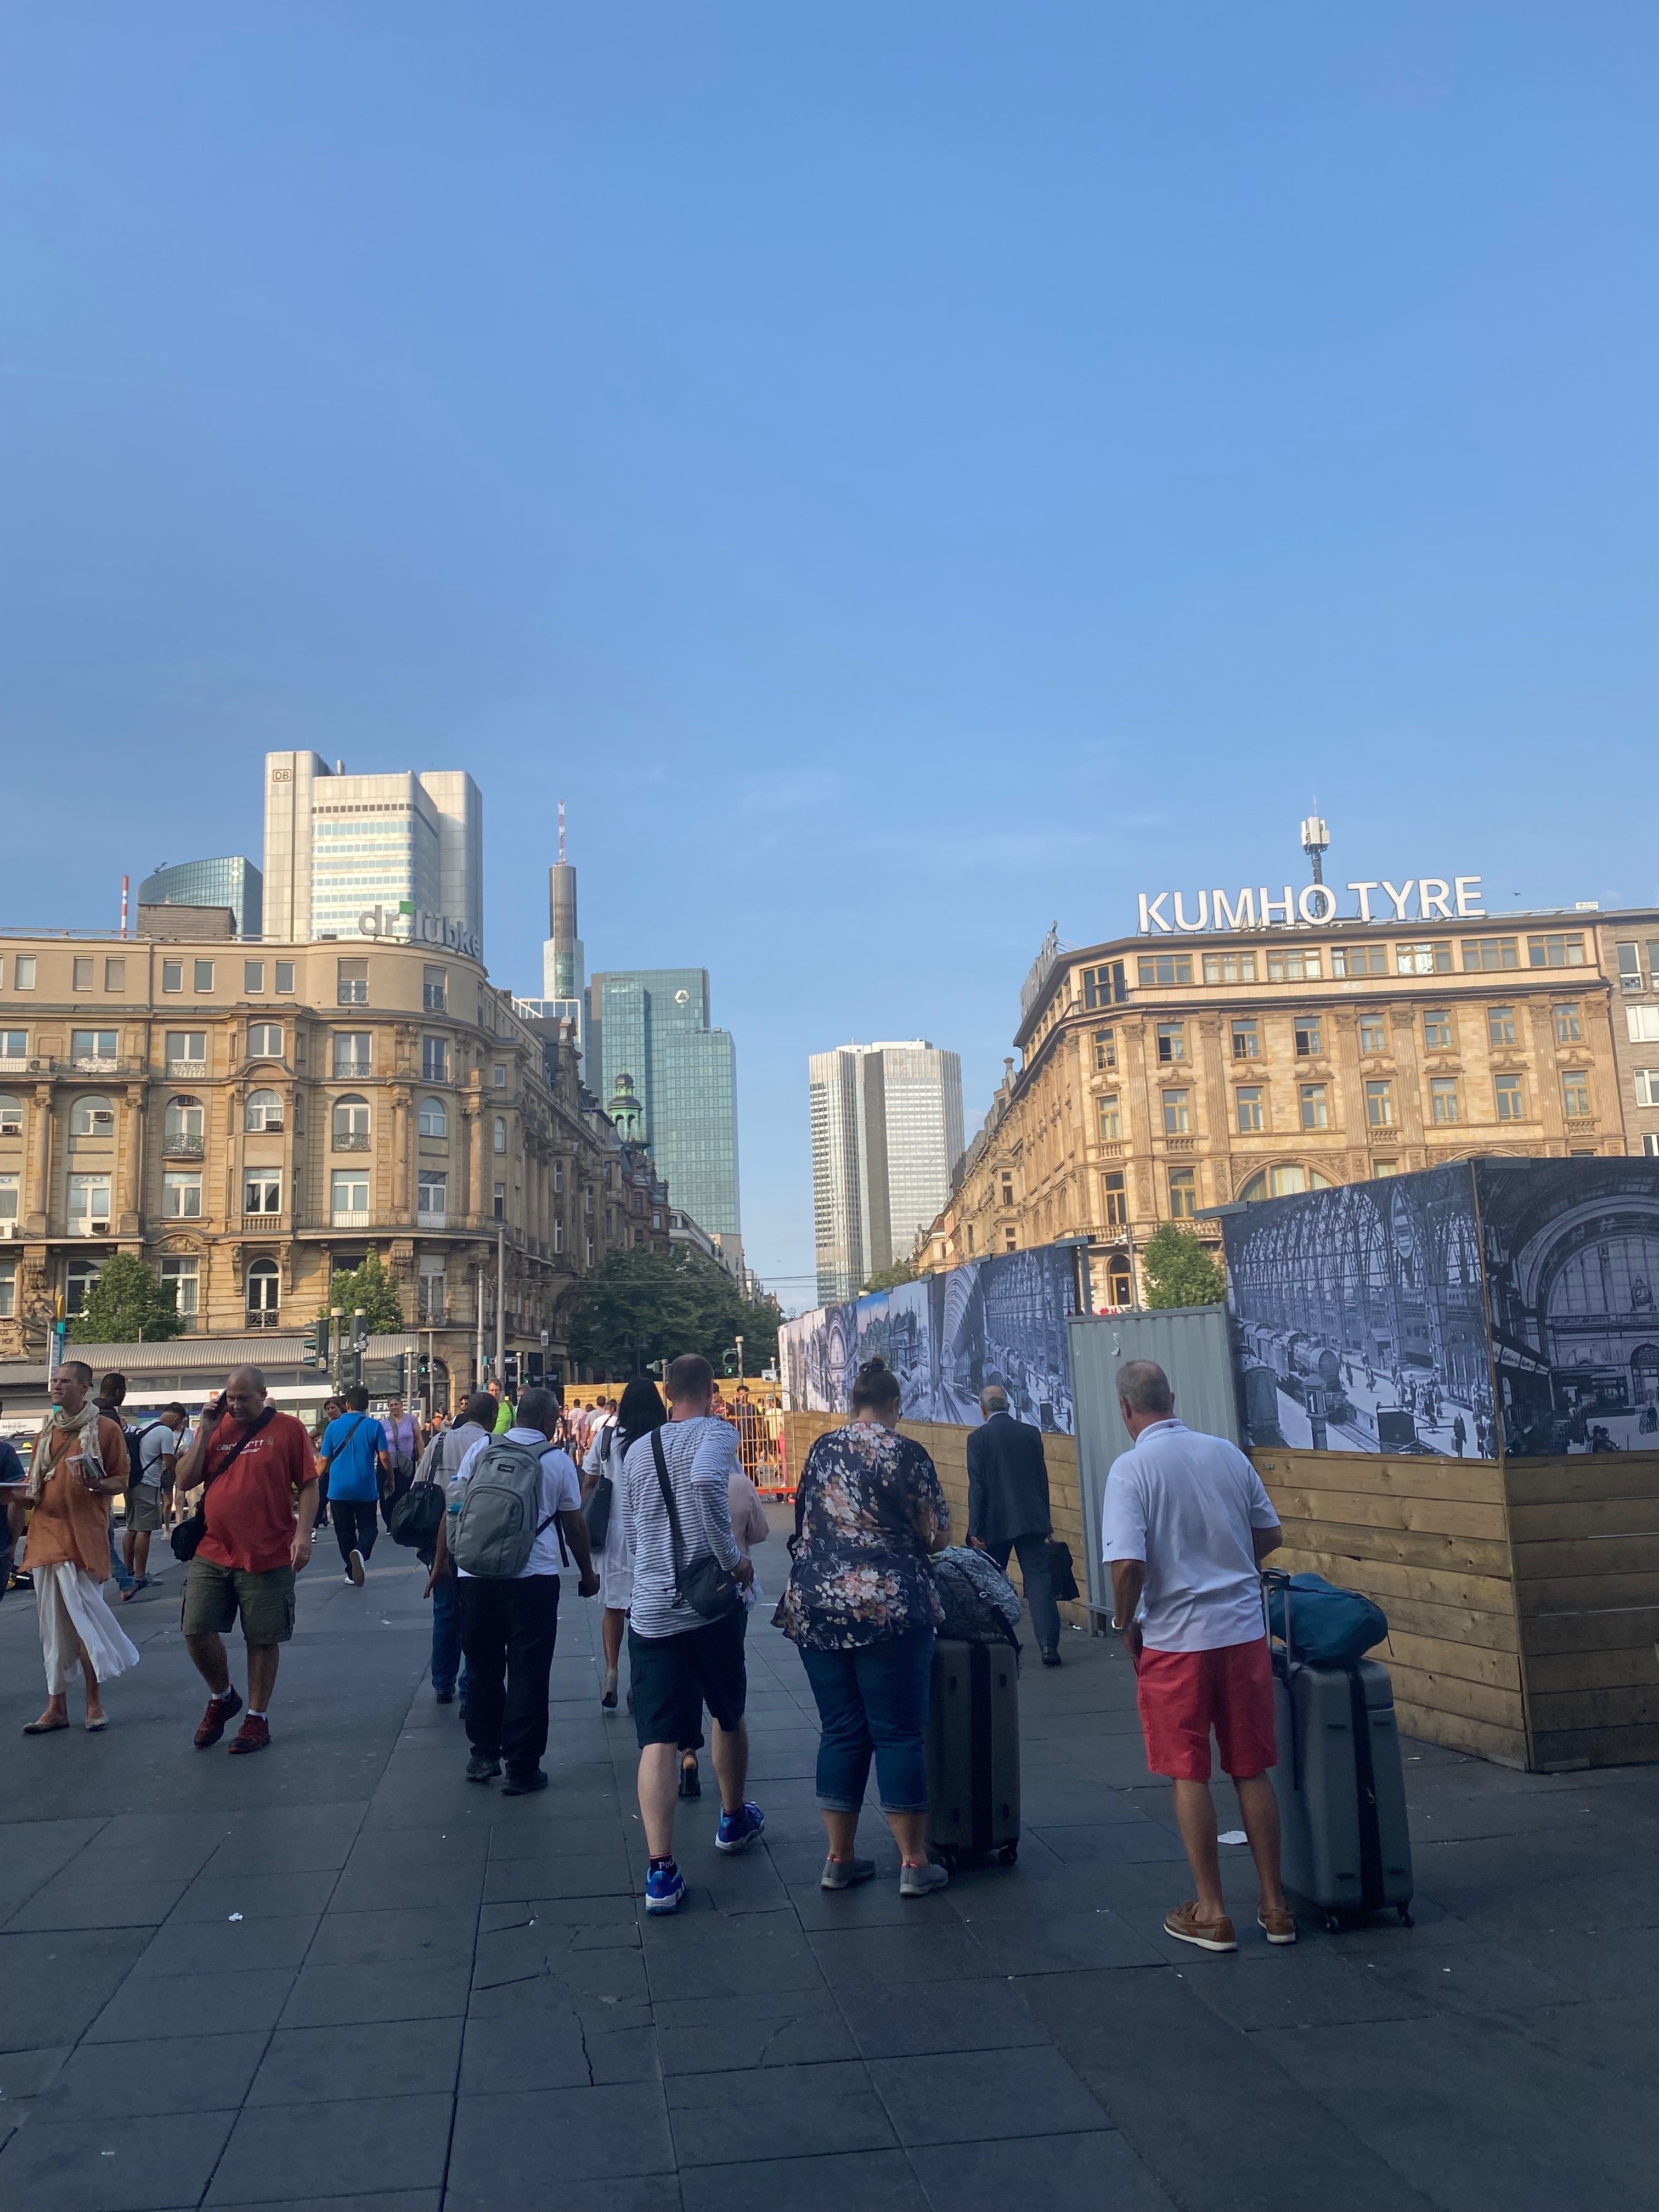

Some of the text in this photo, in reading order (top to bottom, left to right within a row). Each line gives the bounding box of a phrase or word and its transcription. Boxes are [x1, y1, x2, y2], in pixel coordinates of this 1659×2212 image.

[274, 770, 290, 781] DB
[1137, 875, 1487, 934] KUMHO TYRE
[358, 905, 481, 958] dr lübke
[216, 1440, 264, 1451] carrtt
